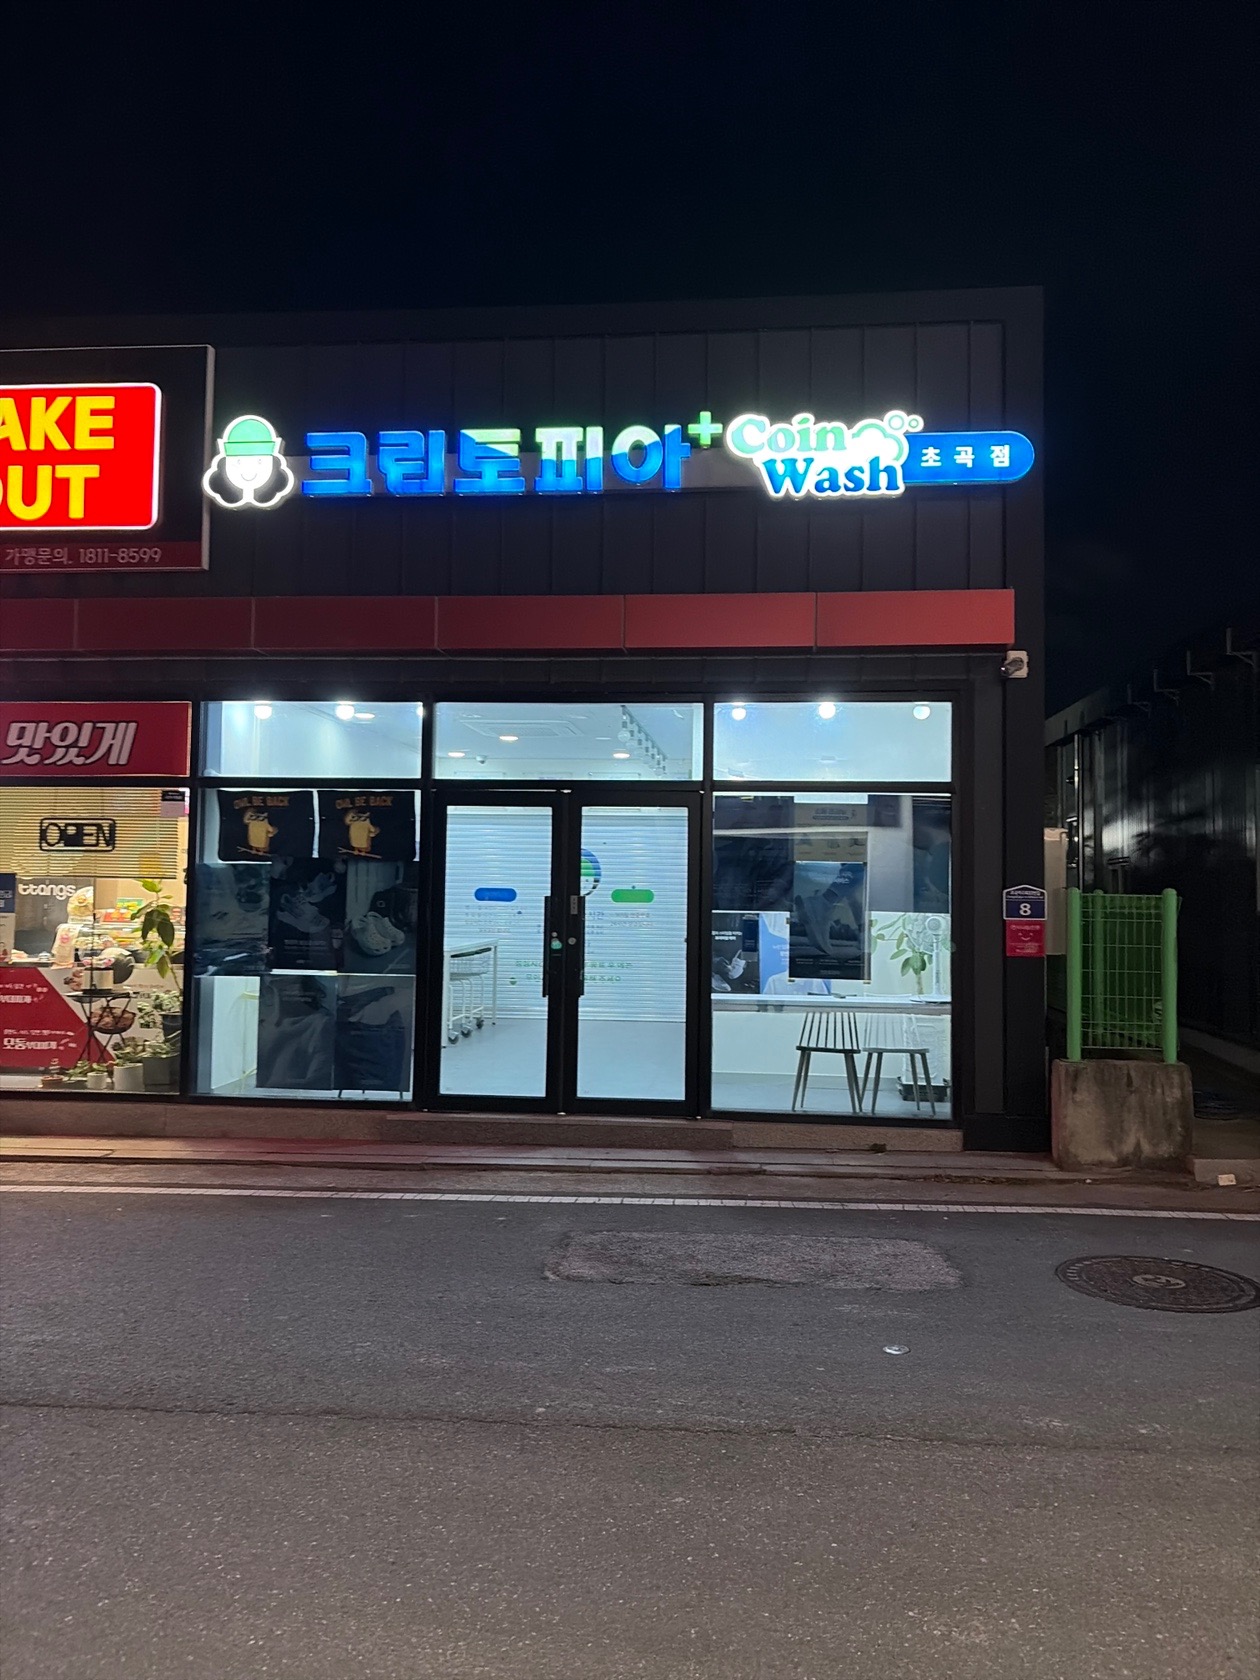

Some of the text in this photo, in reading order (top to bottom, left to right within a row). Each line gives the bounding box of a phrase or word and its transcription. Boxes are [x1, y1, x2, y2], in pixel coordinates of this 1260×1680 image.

[730, 416, 848, 454] Coin
[302, 424, 691, 495] 크린토피아
[762, 456, 900, 495] Wash
[0, 464, 100, 520] UT
[79, 547, 162, 563] 1811-8599
[2, 722, 137, 766] 맛있게
[45, 822, 115, 847] OPEN
[1019, 903, 1031, 916] 8
